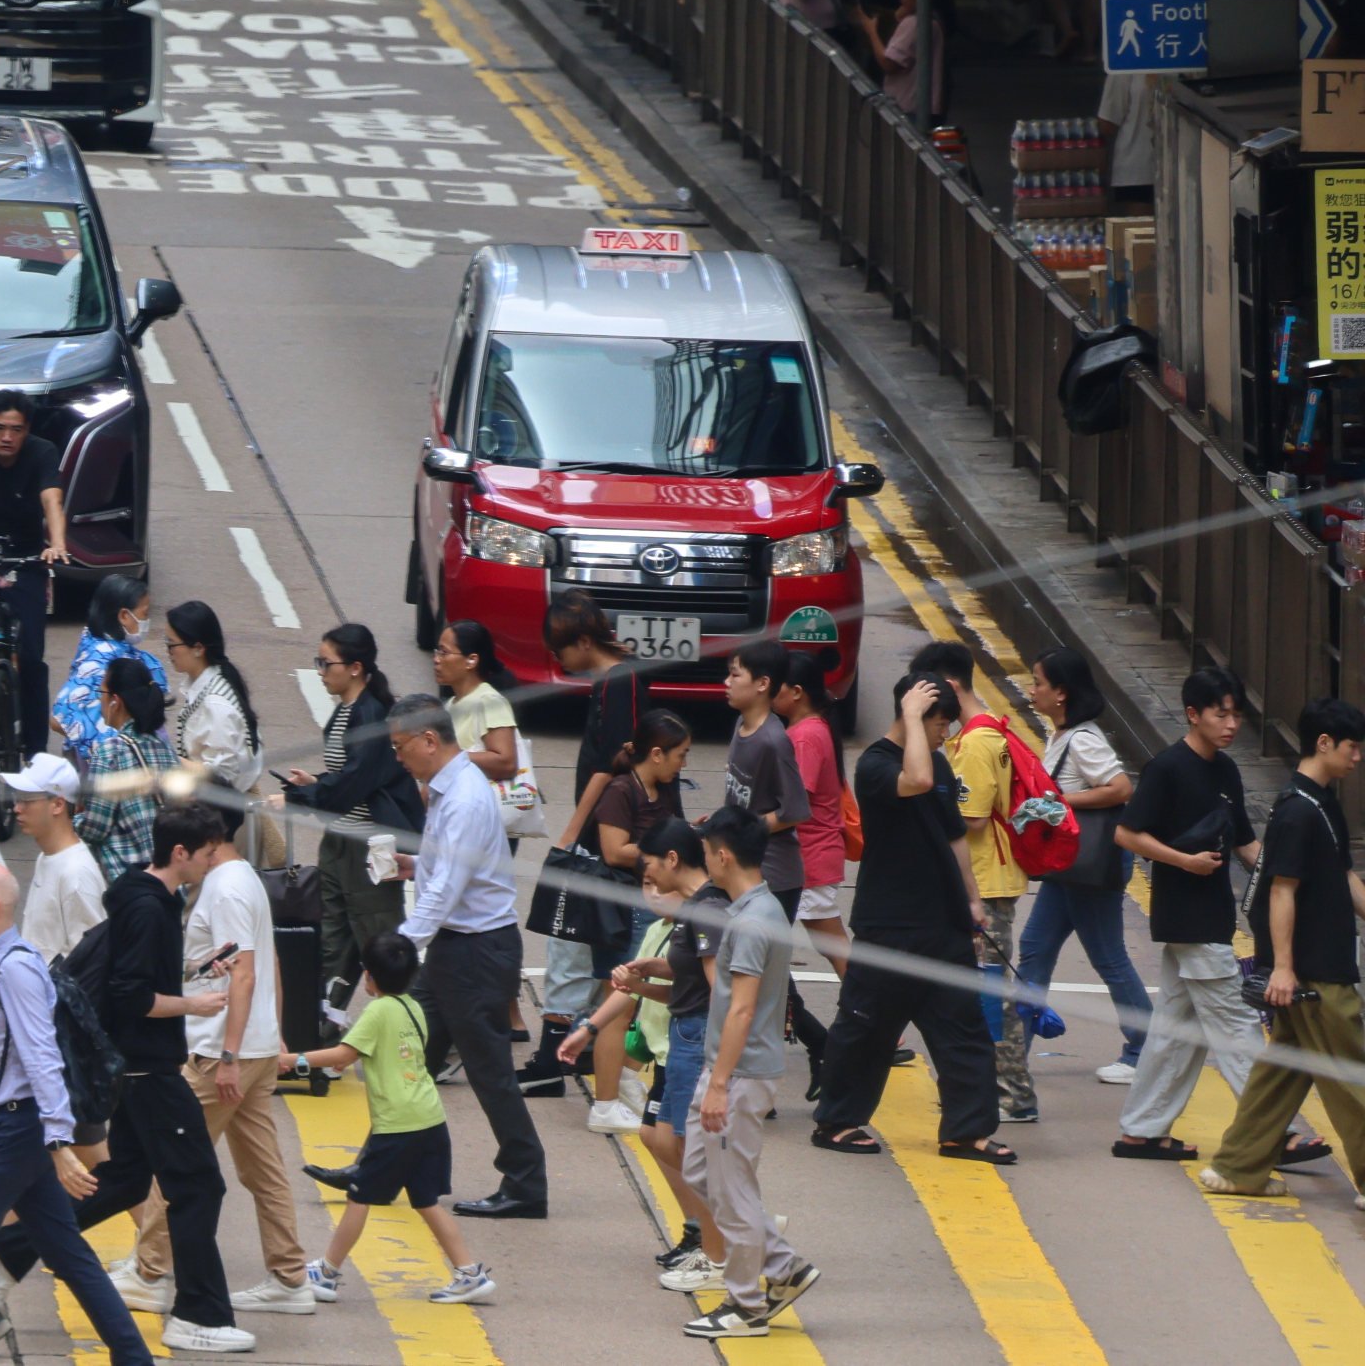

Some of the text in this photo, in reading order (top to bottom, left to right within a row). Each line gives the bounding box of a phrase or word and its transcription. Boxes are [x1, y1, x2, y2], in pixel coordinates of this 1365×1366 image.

[162, 9, 418, 39] ROA
[165, 35, 470, 66] CHAT
[151, 136, 577, 177] STREE
[593, 231, 681, 252] TAXI
[1326, 211, 1365, 244] 弱
[1327, 247, 1365, 280] 的
[642, 617, 676, 638] TT
